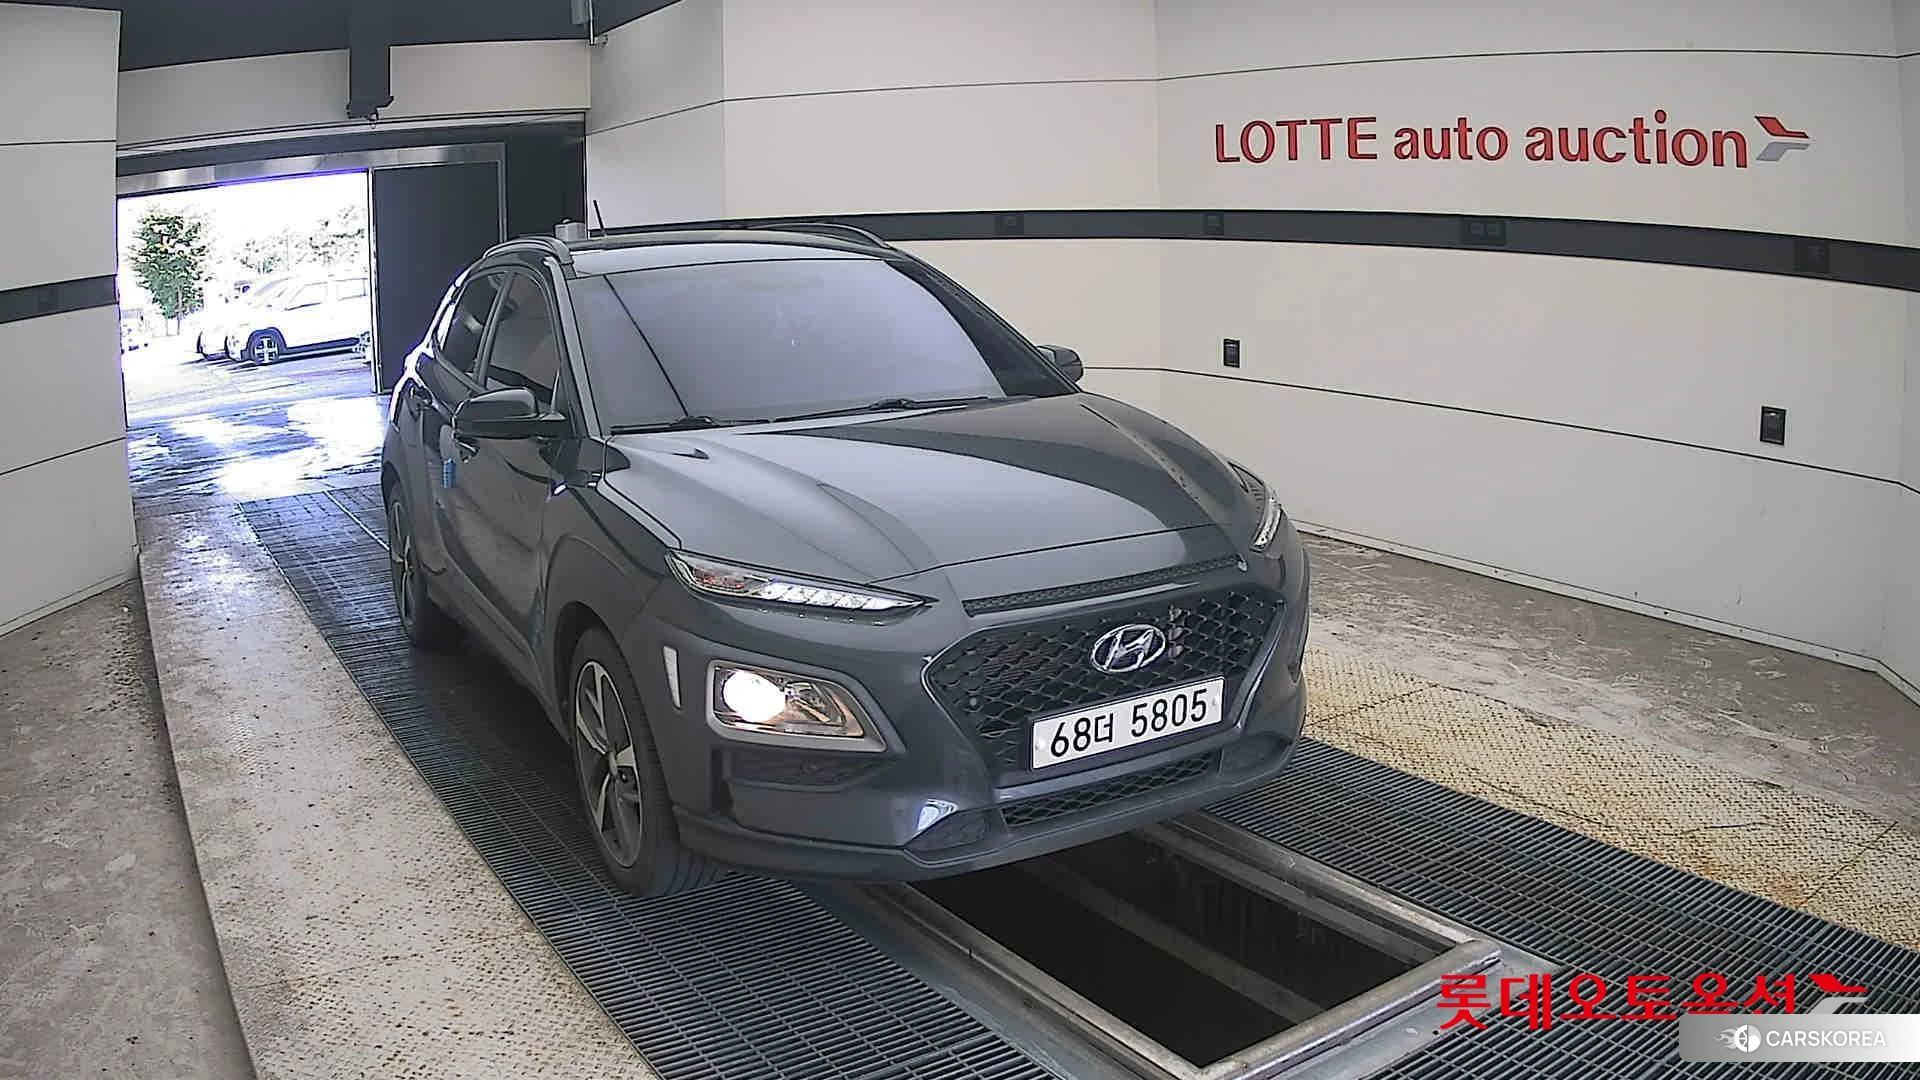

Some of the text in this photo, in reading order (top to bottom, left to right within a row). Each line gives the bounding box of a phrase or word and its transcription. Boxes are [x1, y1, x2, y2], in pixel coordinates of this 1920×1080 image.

[1215, 110, 1748, 168] LOTTE auto auction
[1050, 688, 1207, 758] 68더 5805
